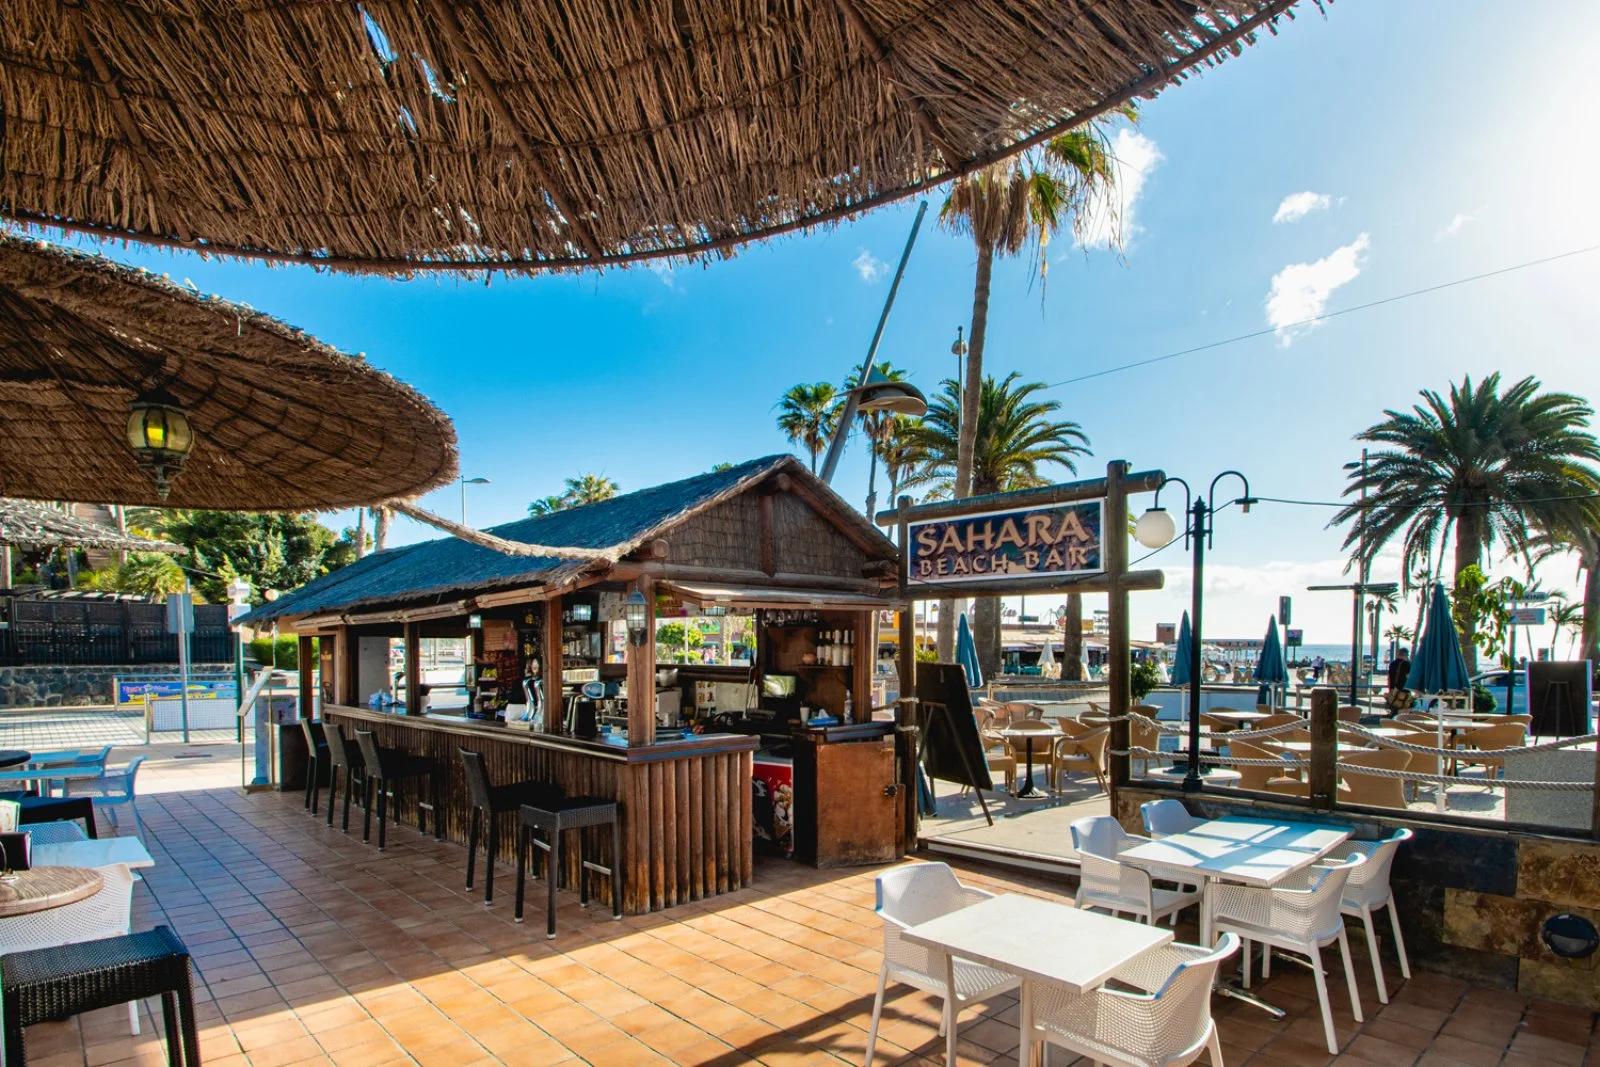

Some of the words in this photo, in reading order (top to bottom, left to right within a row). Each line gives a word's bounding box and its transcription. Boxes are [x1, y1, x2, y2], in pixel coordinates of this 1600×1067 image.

[917, 511, 1090, 556] SAHARA
[920, 553, 1009, 576] BEACH
[1025, 546, 1089, 570] BAR
